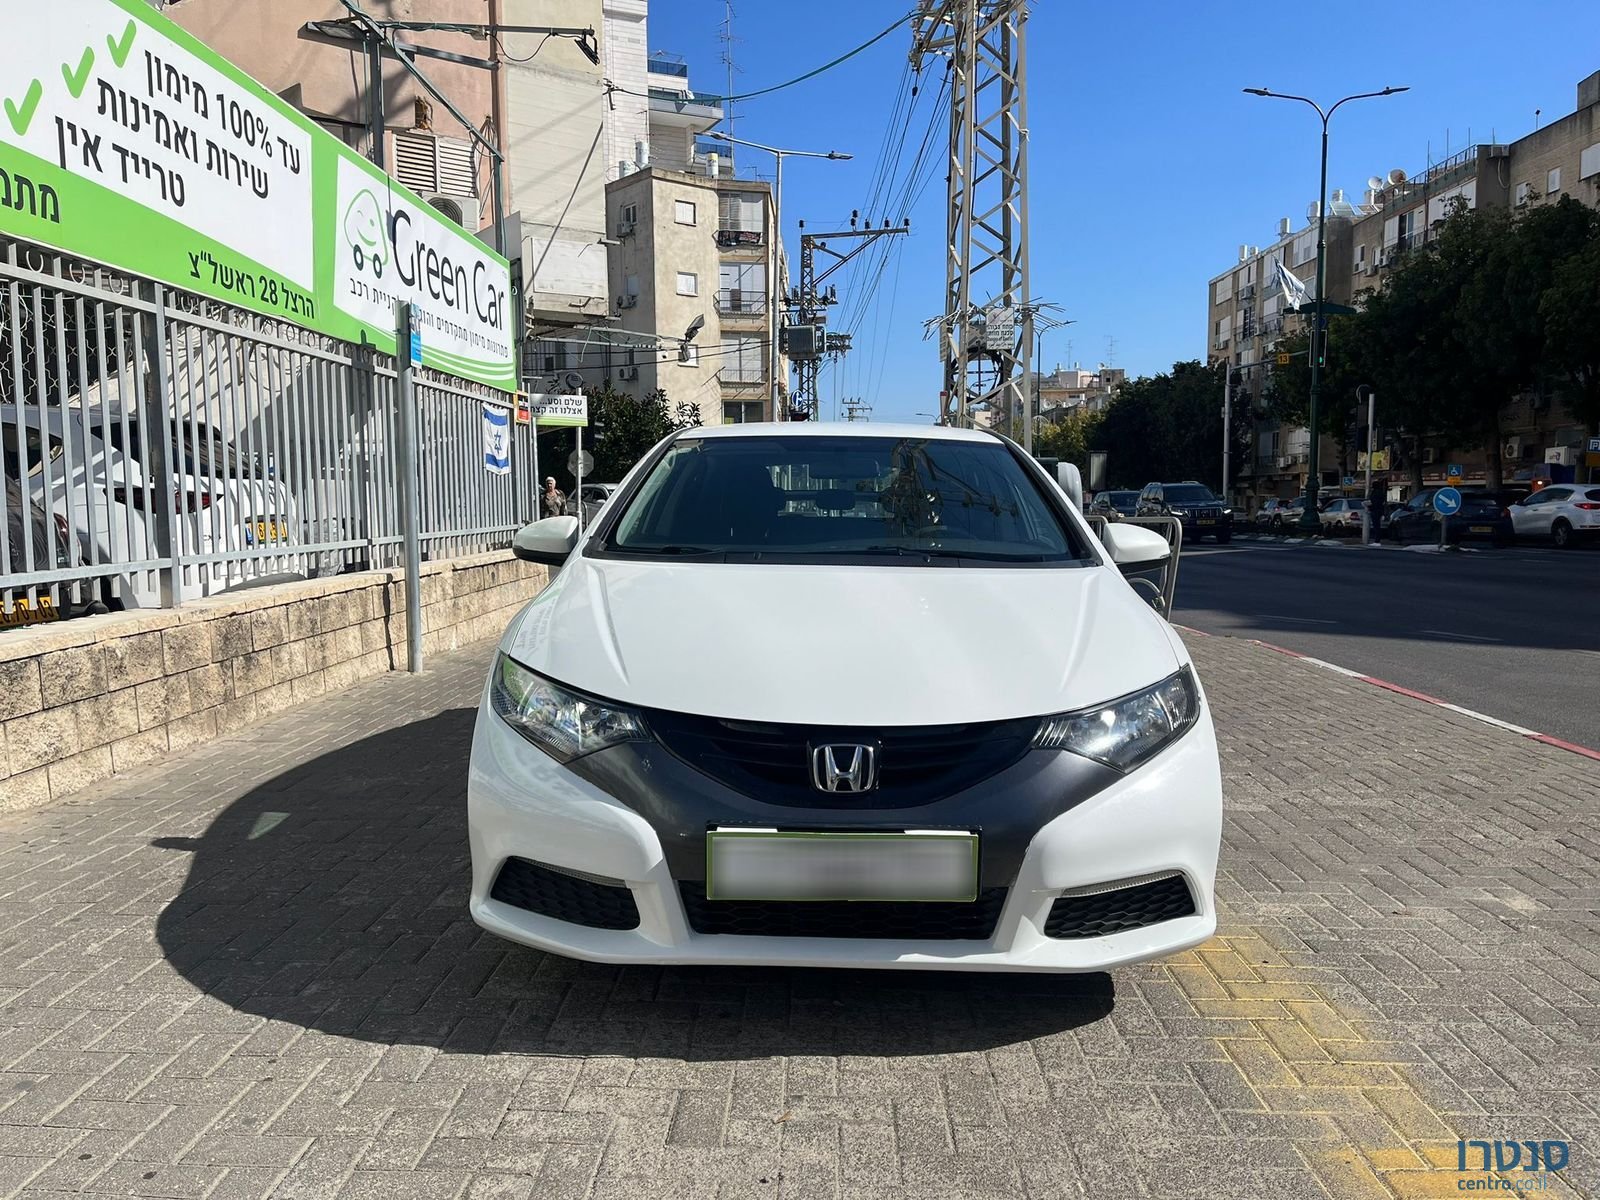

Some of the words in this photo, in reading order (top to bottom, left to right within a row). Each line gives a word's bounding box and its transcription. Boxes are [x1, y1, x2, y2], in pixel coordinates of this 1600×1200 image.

[145, 50, 209, 119] מימון
[55, 116, 103, 173] אין
[97, 78, 198, 164] ואמינות
[216, 94, 272, 158] 100%
[112, 143, 185, 207] טרייד
[206, 139, 269, 199] שירות
[277, 136, 300, 175] עד
[260, 275, 278, 306] 28
[350, 278, 369, 301] רכב
[393, 209, 469, 315] Green
[473, 261, 505, 331] Car
[281, 282, 314, 319] הרצל
[1280, 355, 1288, 363] 13
[560, 407, 582, 415] אצלנו
[564, 398, 582, 406] שלם
